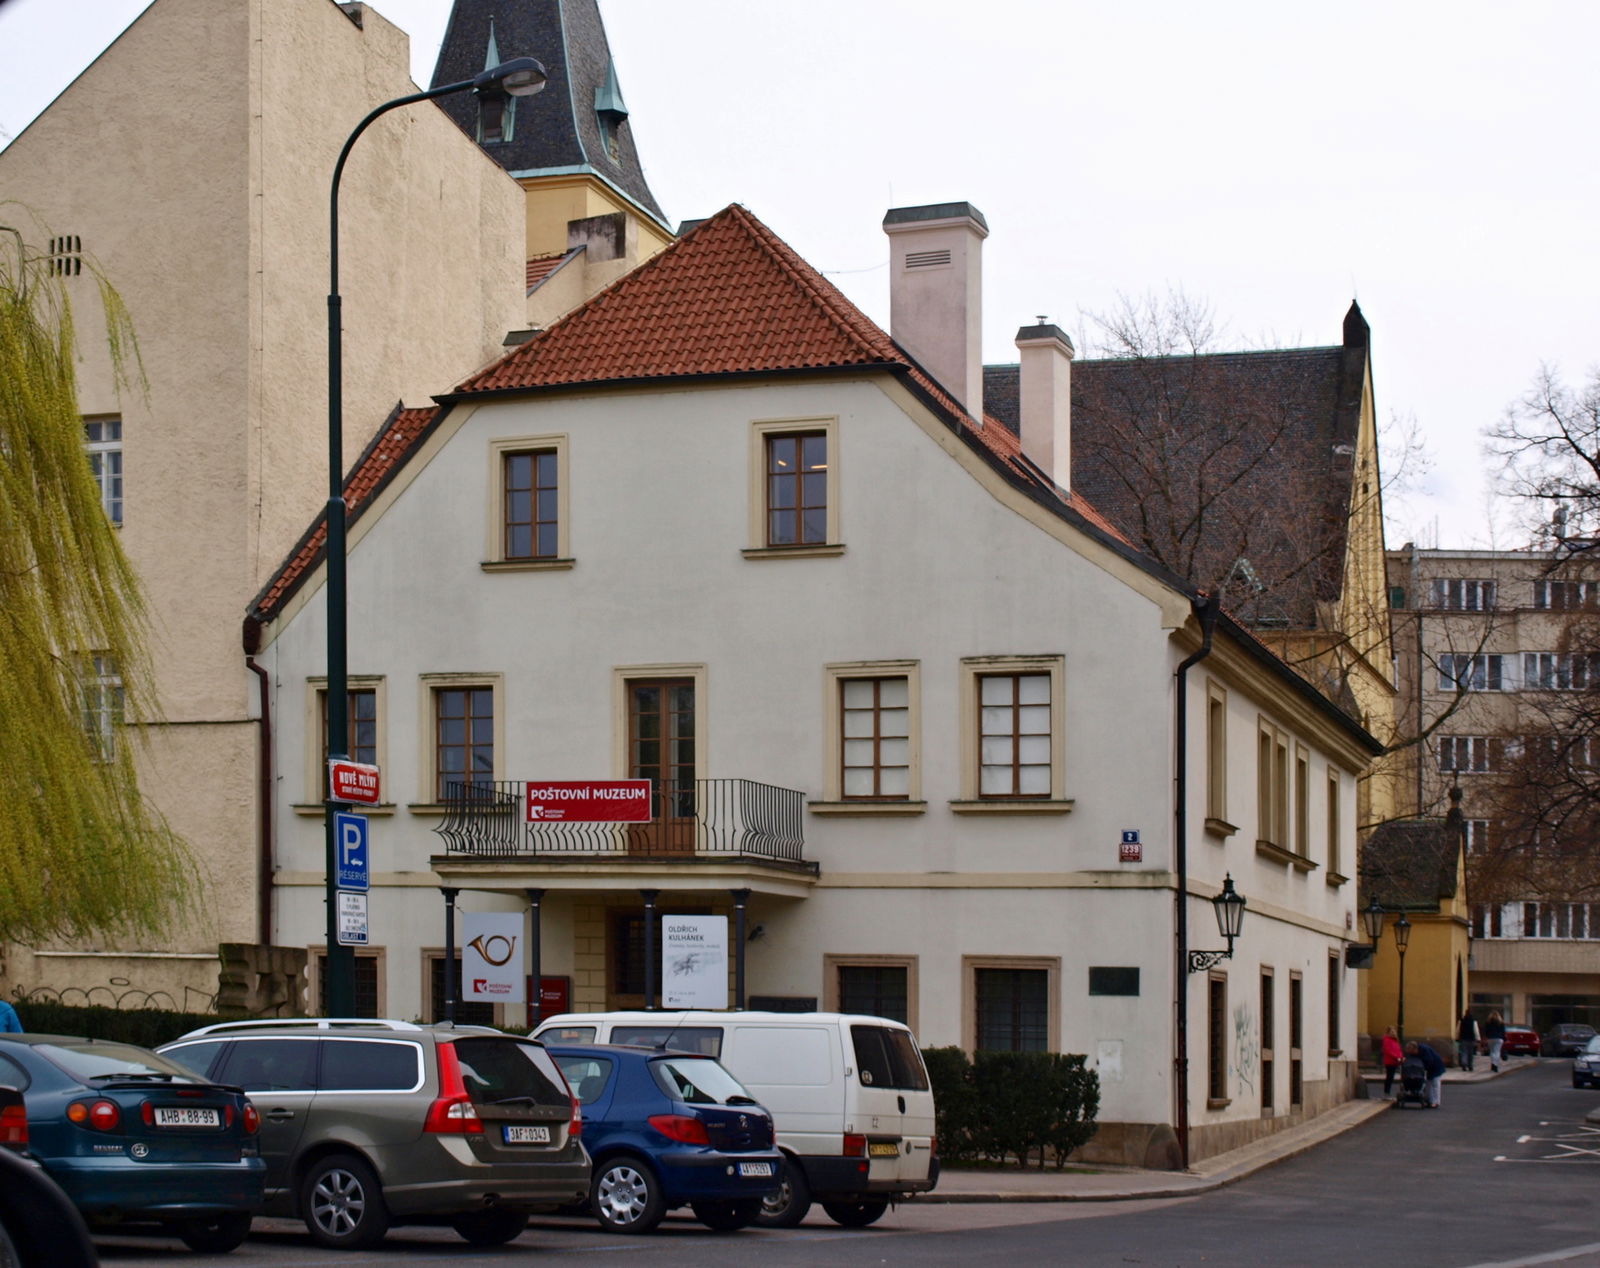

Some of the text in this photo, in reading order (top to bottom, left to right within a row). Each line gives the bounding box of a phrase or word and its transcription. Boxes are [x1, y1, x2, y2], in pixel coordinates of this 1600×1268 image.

[339, 771, 357, 785] NOVÉ
[531, 786, 646, 800] POŠTOVNÍ MUZEUM
[1127, 832, 1133, 841] 2
[343, 823, 362, 865] P
[1121, 844, 1139, 853] 1239
[668, 925, 698, 933] OLDŘICH
[668, 933, 704, 941] KULHÁNEK
[161, 1109, 215, 1124] AHB 88-99
[510, 1128, 547, 1141] 3AF 0343
